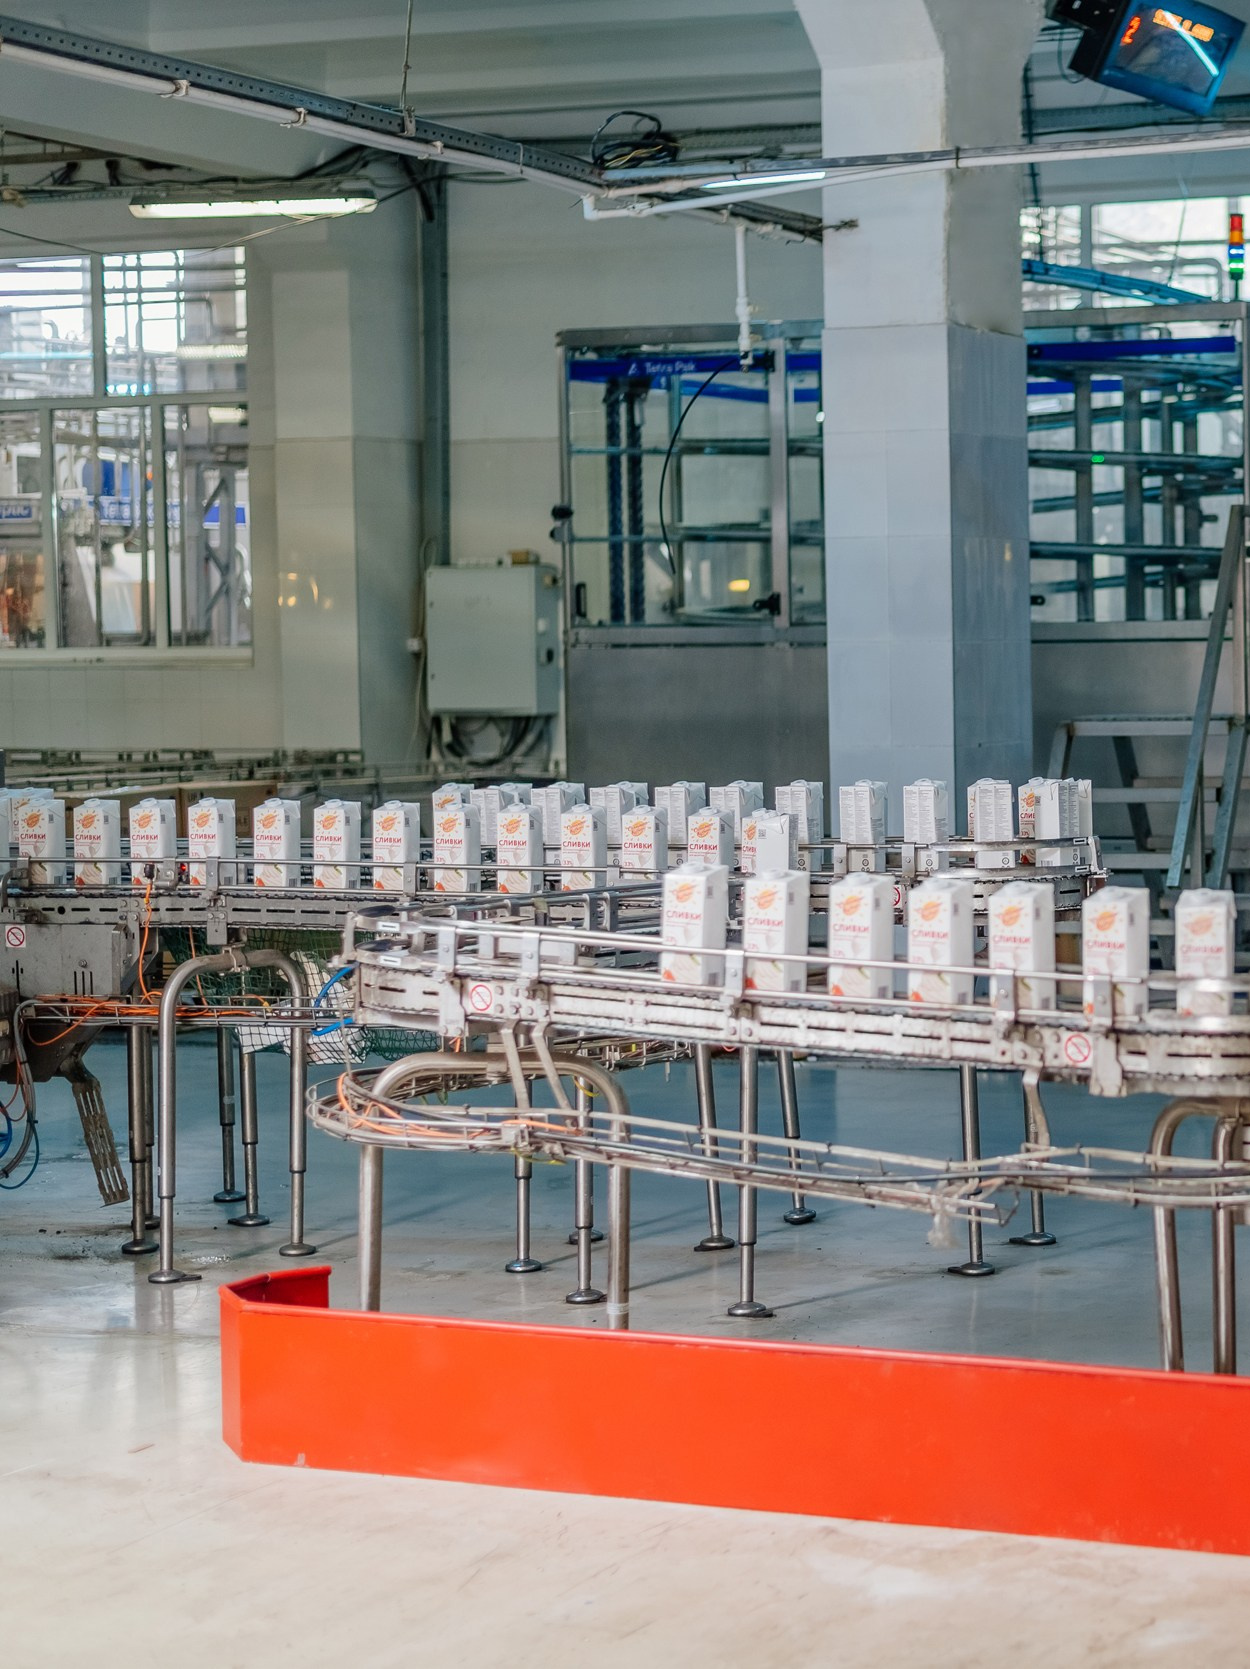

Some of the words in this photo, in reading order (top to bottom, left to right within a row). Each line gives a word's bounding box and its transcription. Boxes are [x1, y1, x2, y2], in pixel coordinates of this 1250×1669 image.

[374, 836, 402, 844] СЛИВКИ
[498, 839, 527, 847] СЛИВКИ
[689, 843, 718, 851] СЛИВКИ
[666, 909, 702, 920] СЛИВКИ
[747, 917, 783, 927] СЛИВКИ
[833, 923, 870, 933] СЛИВКИ
[911, 929, 949, 939] СЛИВКИ
